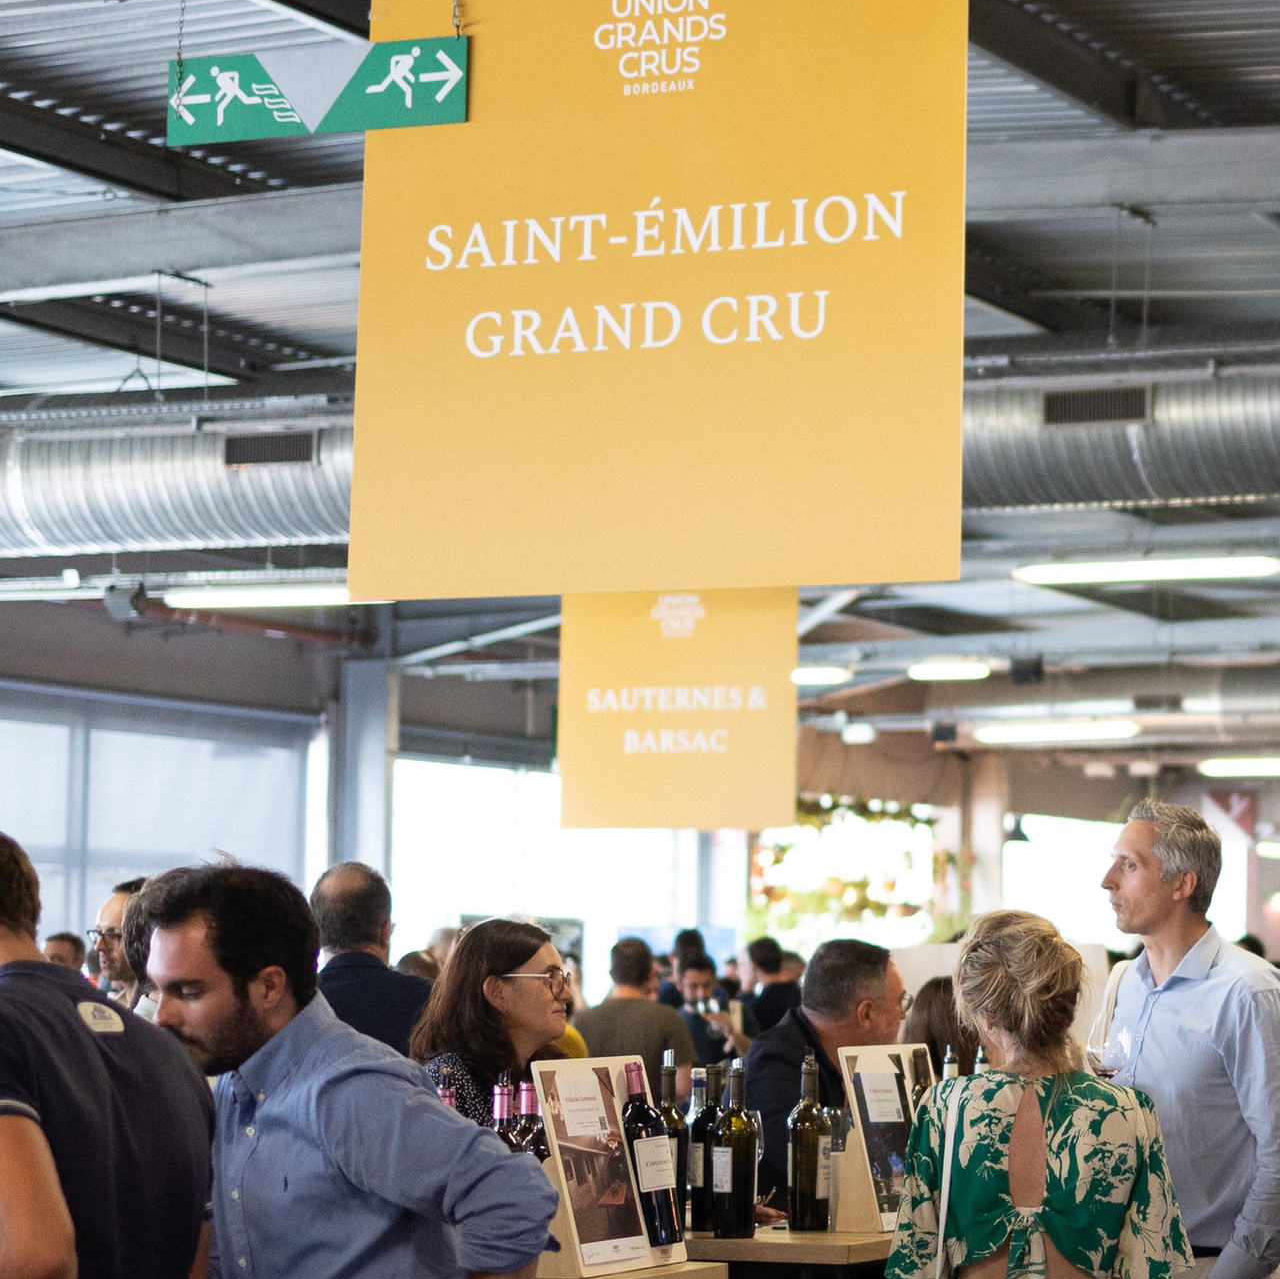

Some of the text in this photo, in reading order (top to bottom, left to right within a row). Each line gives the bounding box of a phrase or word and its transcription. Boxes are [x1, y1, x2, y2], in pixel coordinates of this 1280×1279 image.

[594, 13, 726, 50] GRANDS
[619, 46, 700, 78] CRUS
[623, 79, 695, 96] BORDEAUX
[425, 191, 907, 271] SAINT-ÉMILION
[465, 290, 830, 358] GRAND CRU
[586, 686, 768, 712] SAUTERNES &
[623, 729, 729, 754] BARSAC
